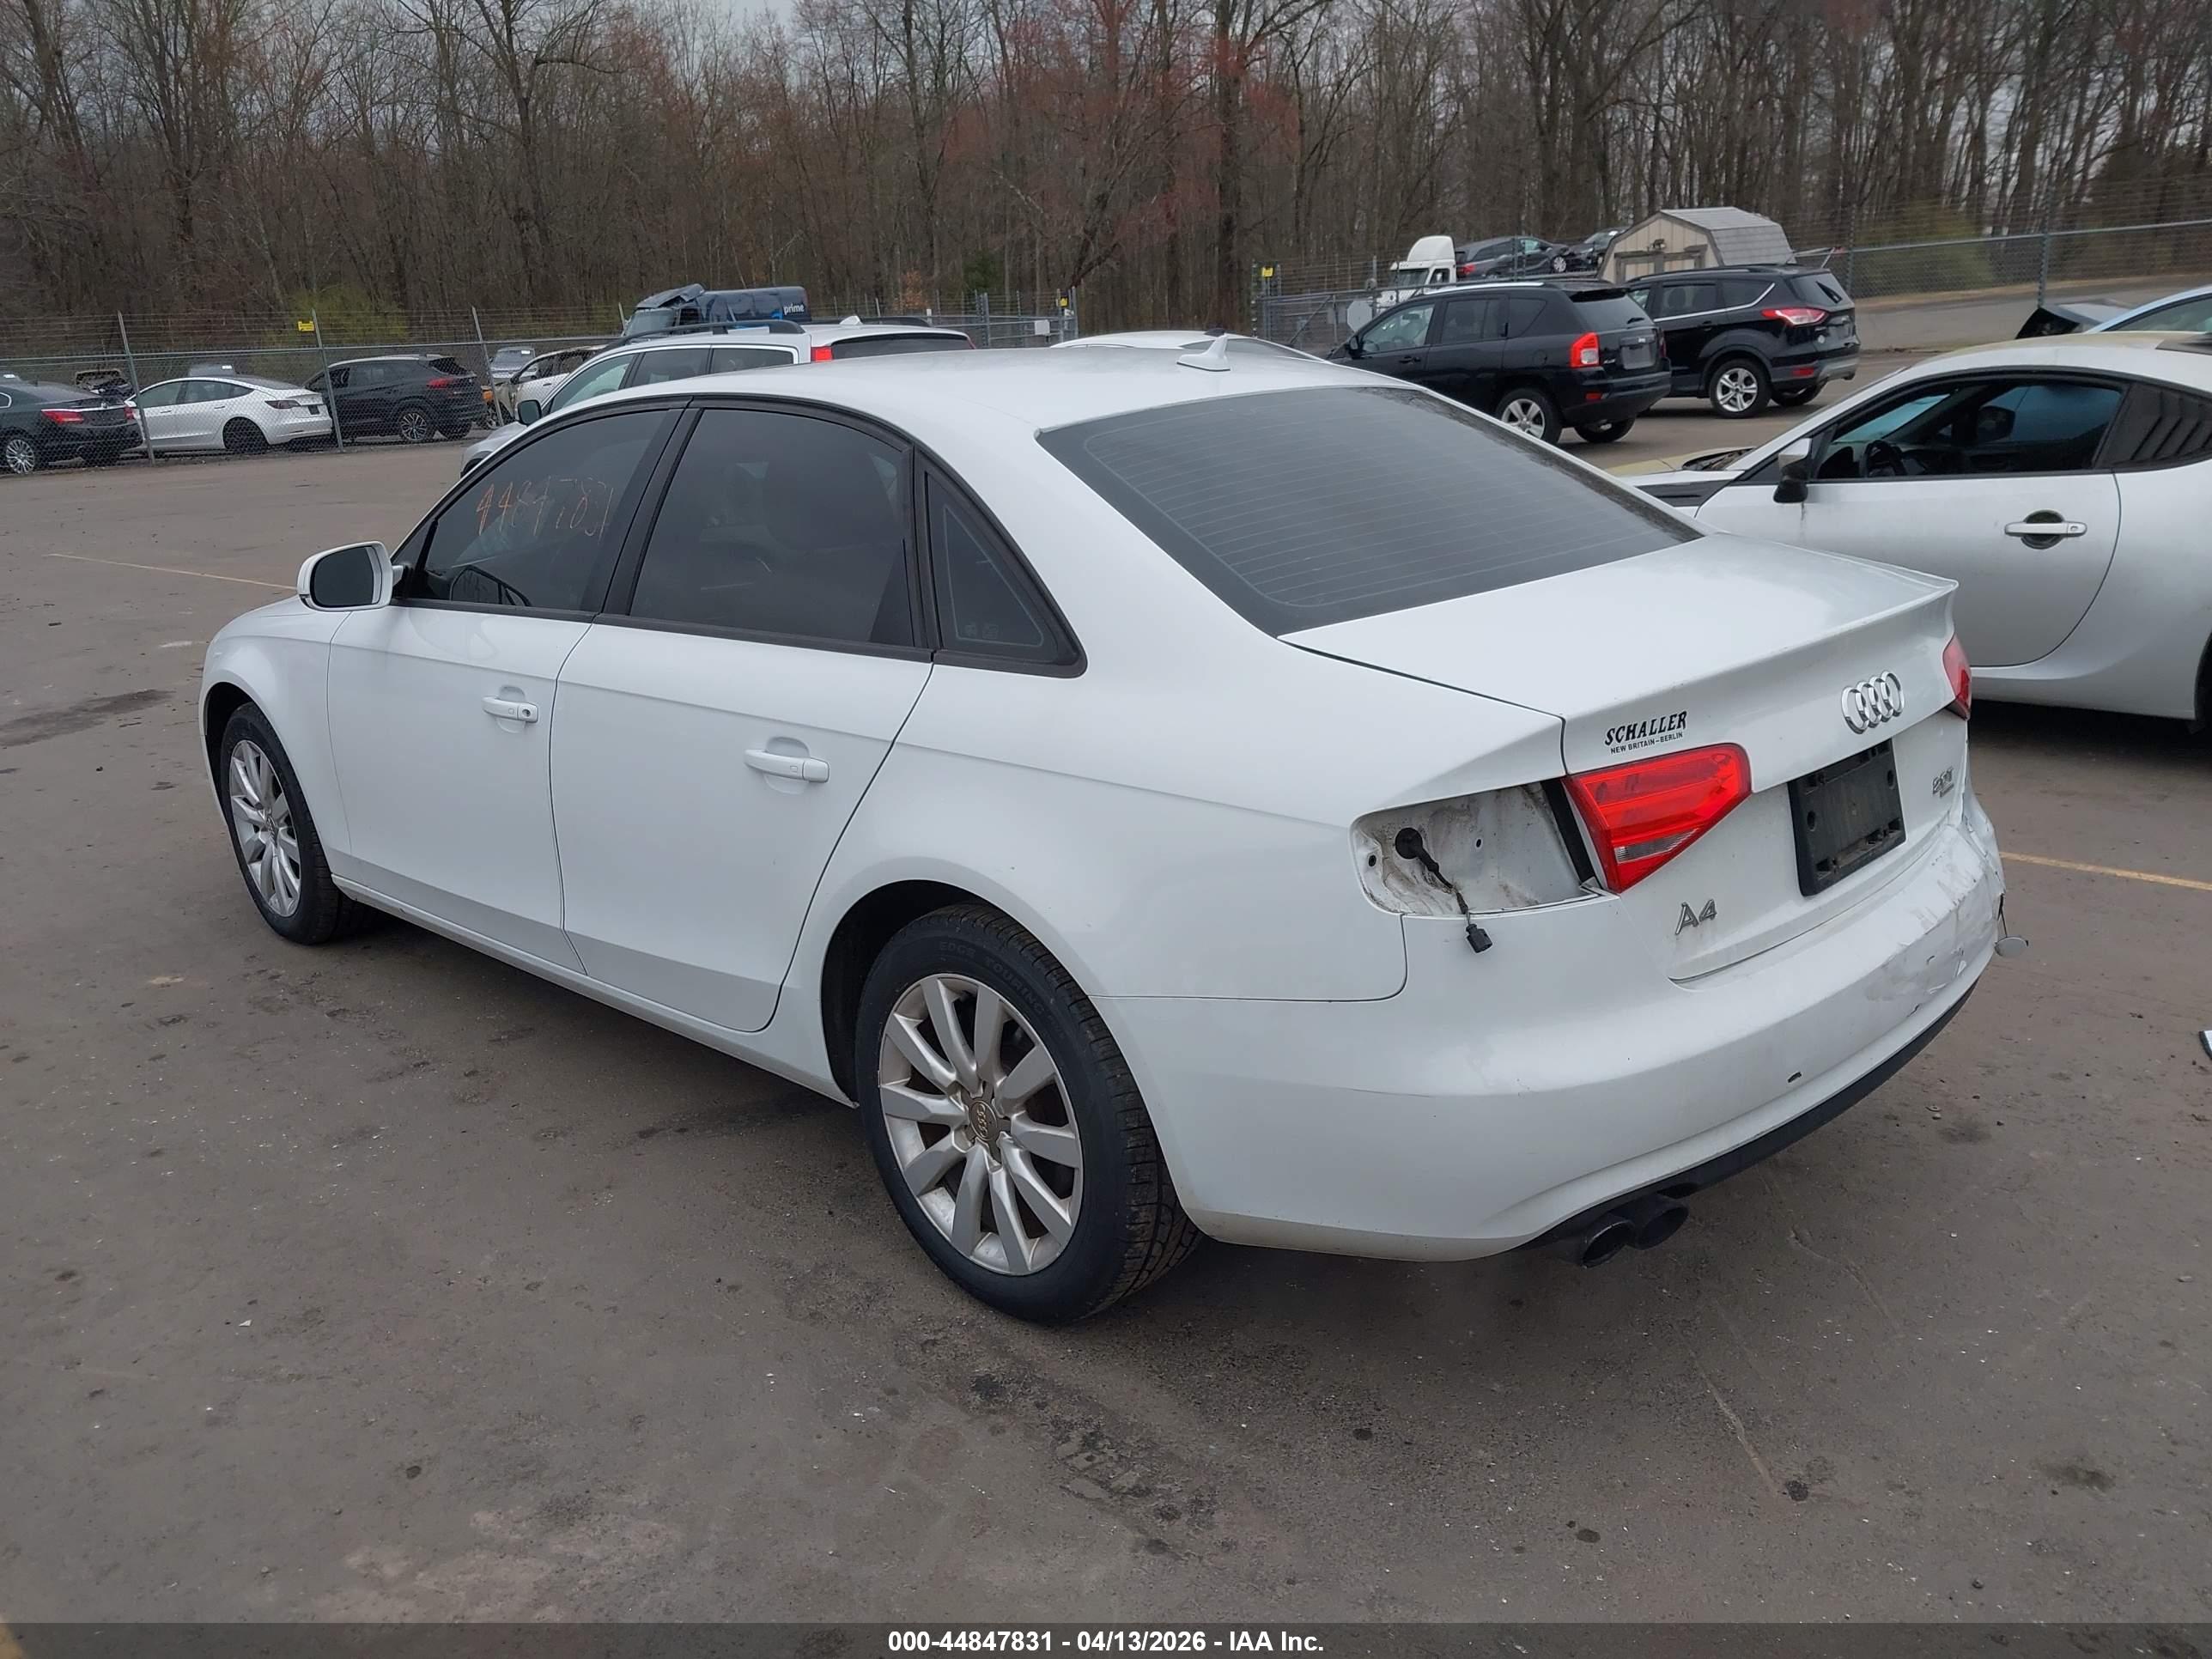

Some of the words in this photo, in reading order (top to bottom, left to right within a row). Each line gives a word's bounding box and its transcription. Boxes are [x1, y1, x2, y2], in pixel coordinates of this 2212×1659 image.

[783, 303, 805, 316] prime
[1604, 710, 1687, 746] SCHALLER
[1610, 744, 1626, 755] NEW
[1674, 898, 1717, 936] A4
[985, 954, 1045, 1015] TOURING
